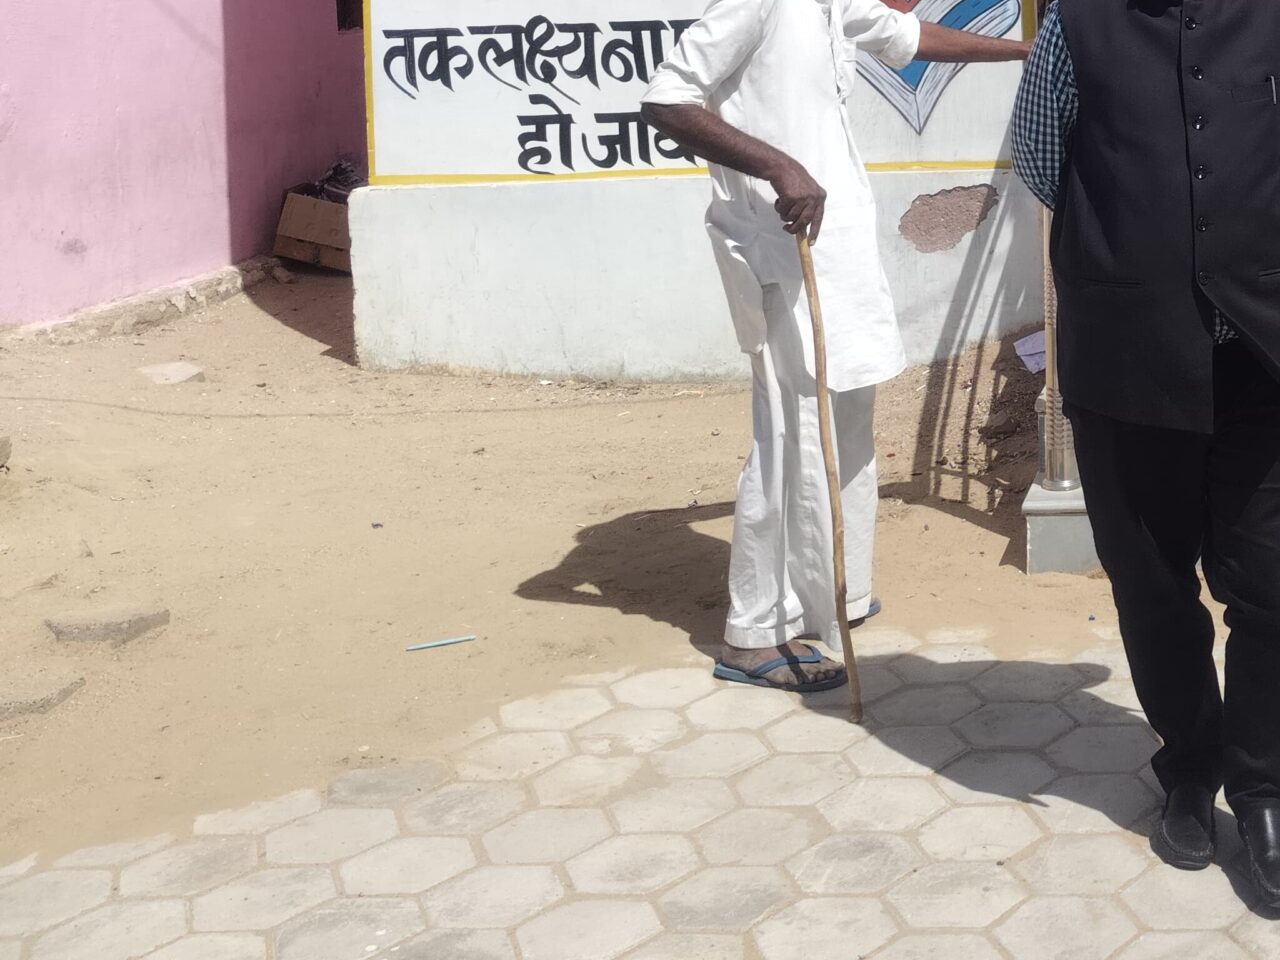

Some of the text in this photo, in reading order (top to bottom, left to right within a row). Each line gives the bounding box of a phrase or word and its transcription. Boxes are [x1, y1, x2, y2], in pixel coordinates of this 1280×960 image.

[382, 28, 474, 100] तक
[467, 15, 603, 105] लक्ष्य
[517, 94, 576, 175] हो
